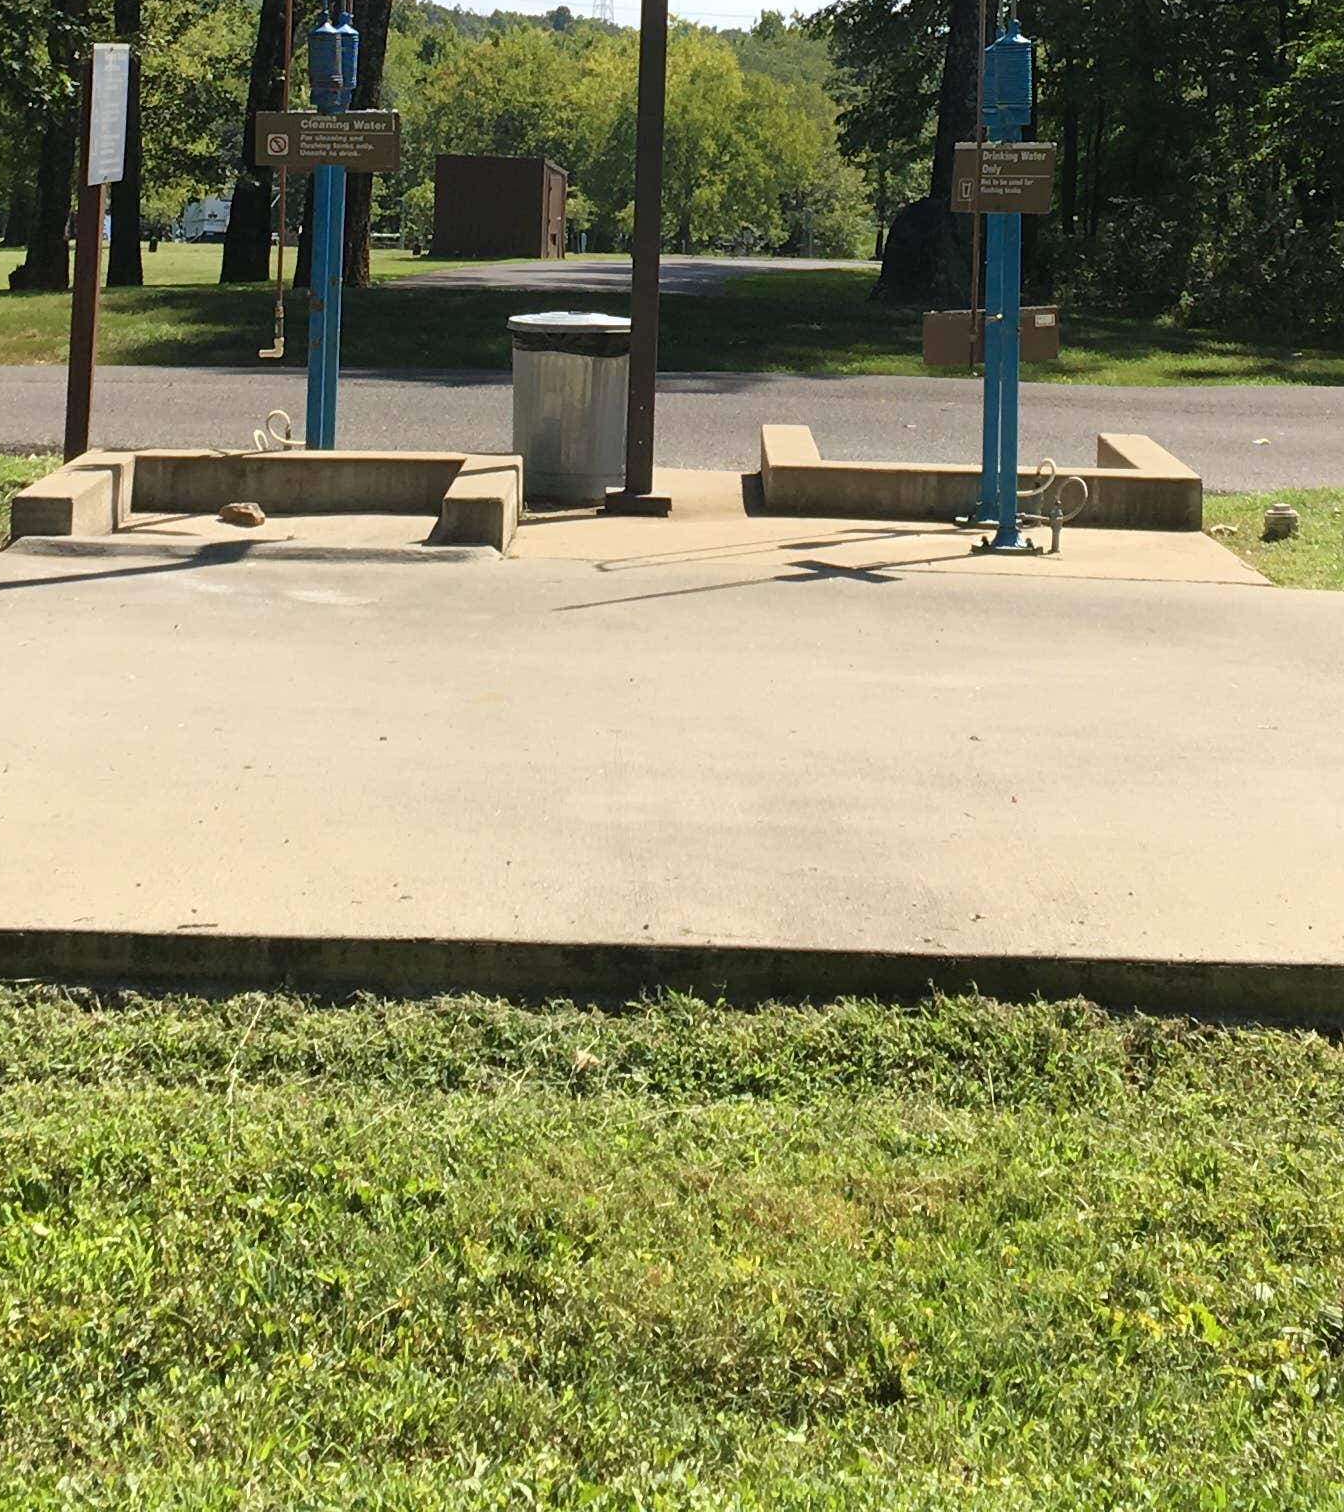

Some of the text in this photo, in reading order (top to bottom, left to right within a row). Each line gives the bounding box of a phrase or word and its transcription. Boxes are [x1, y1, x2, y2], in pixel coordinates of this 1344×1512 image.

[300, 119, 386, 130] Cleaning Water
[982, 150, 1047, 162] Drinking Water
[982, 164, 1002, 175] Only
